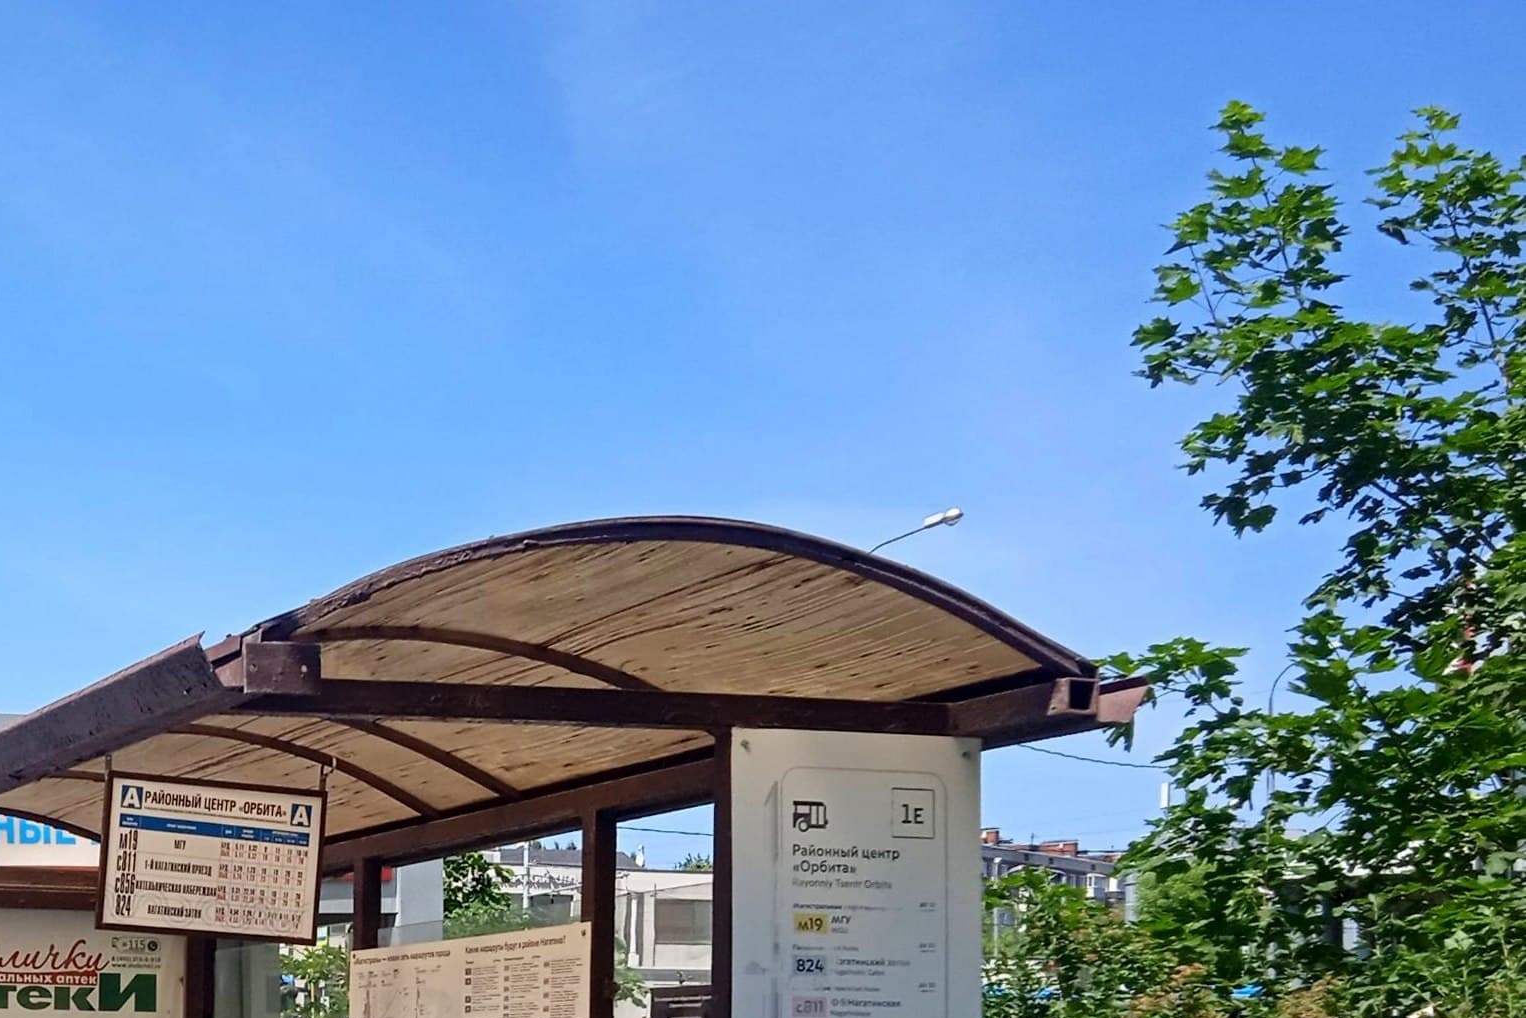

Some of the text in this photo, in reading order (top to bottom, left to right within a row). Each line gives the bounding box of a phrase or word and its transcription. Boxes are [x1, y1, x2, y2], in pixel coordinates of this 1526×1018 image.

[145, 789, 202, 808] РАЙОННЫЙ
[204, 797, 236, 812] ЦЕНТР
[792, 843, 901, 861] Районный центр
[793, 860, 857, 875] «Орбита»
[831, 915, 852, 925] МГУ
[796, 958, 825, 973] 824
[56, 975, 97, 985] аптек
